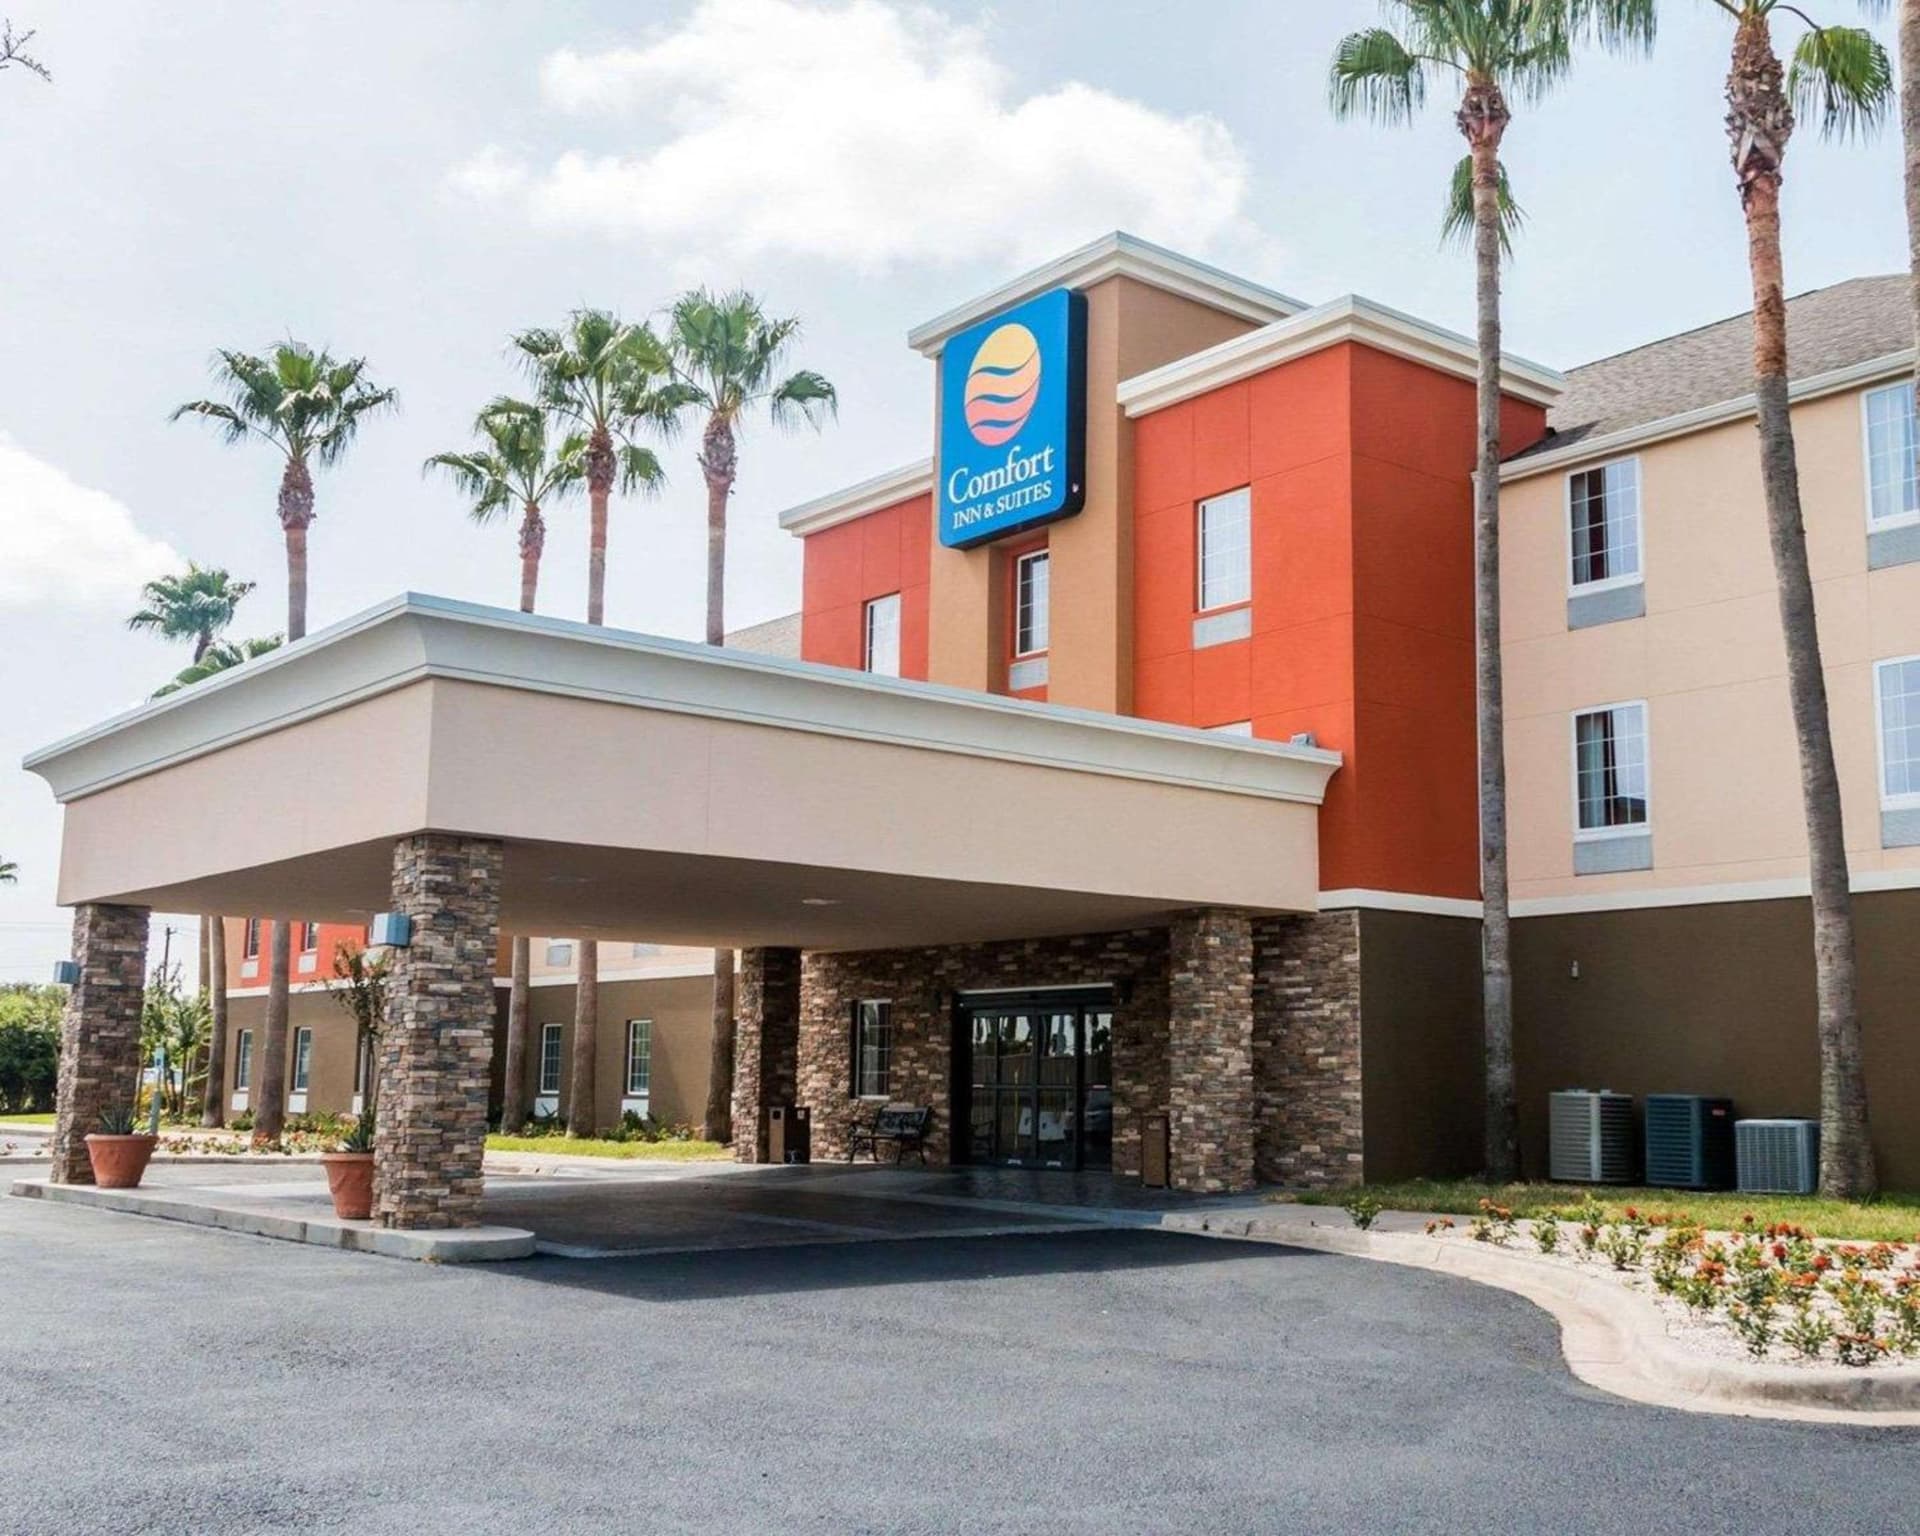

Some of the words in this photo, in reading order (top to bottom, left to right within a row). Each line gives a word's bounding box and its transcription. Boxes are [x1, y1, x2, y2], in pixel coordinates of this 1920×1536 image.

[948, 444, 1055, 504] Comfort
[953, 505, 982, 529] INN
[984, 503, 995, 518] &
[996, 480, 1052, 514] SUITES
